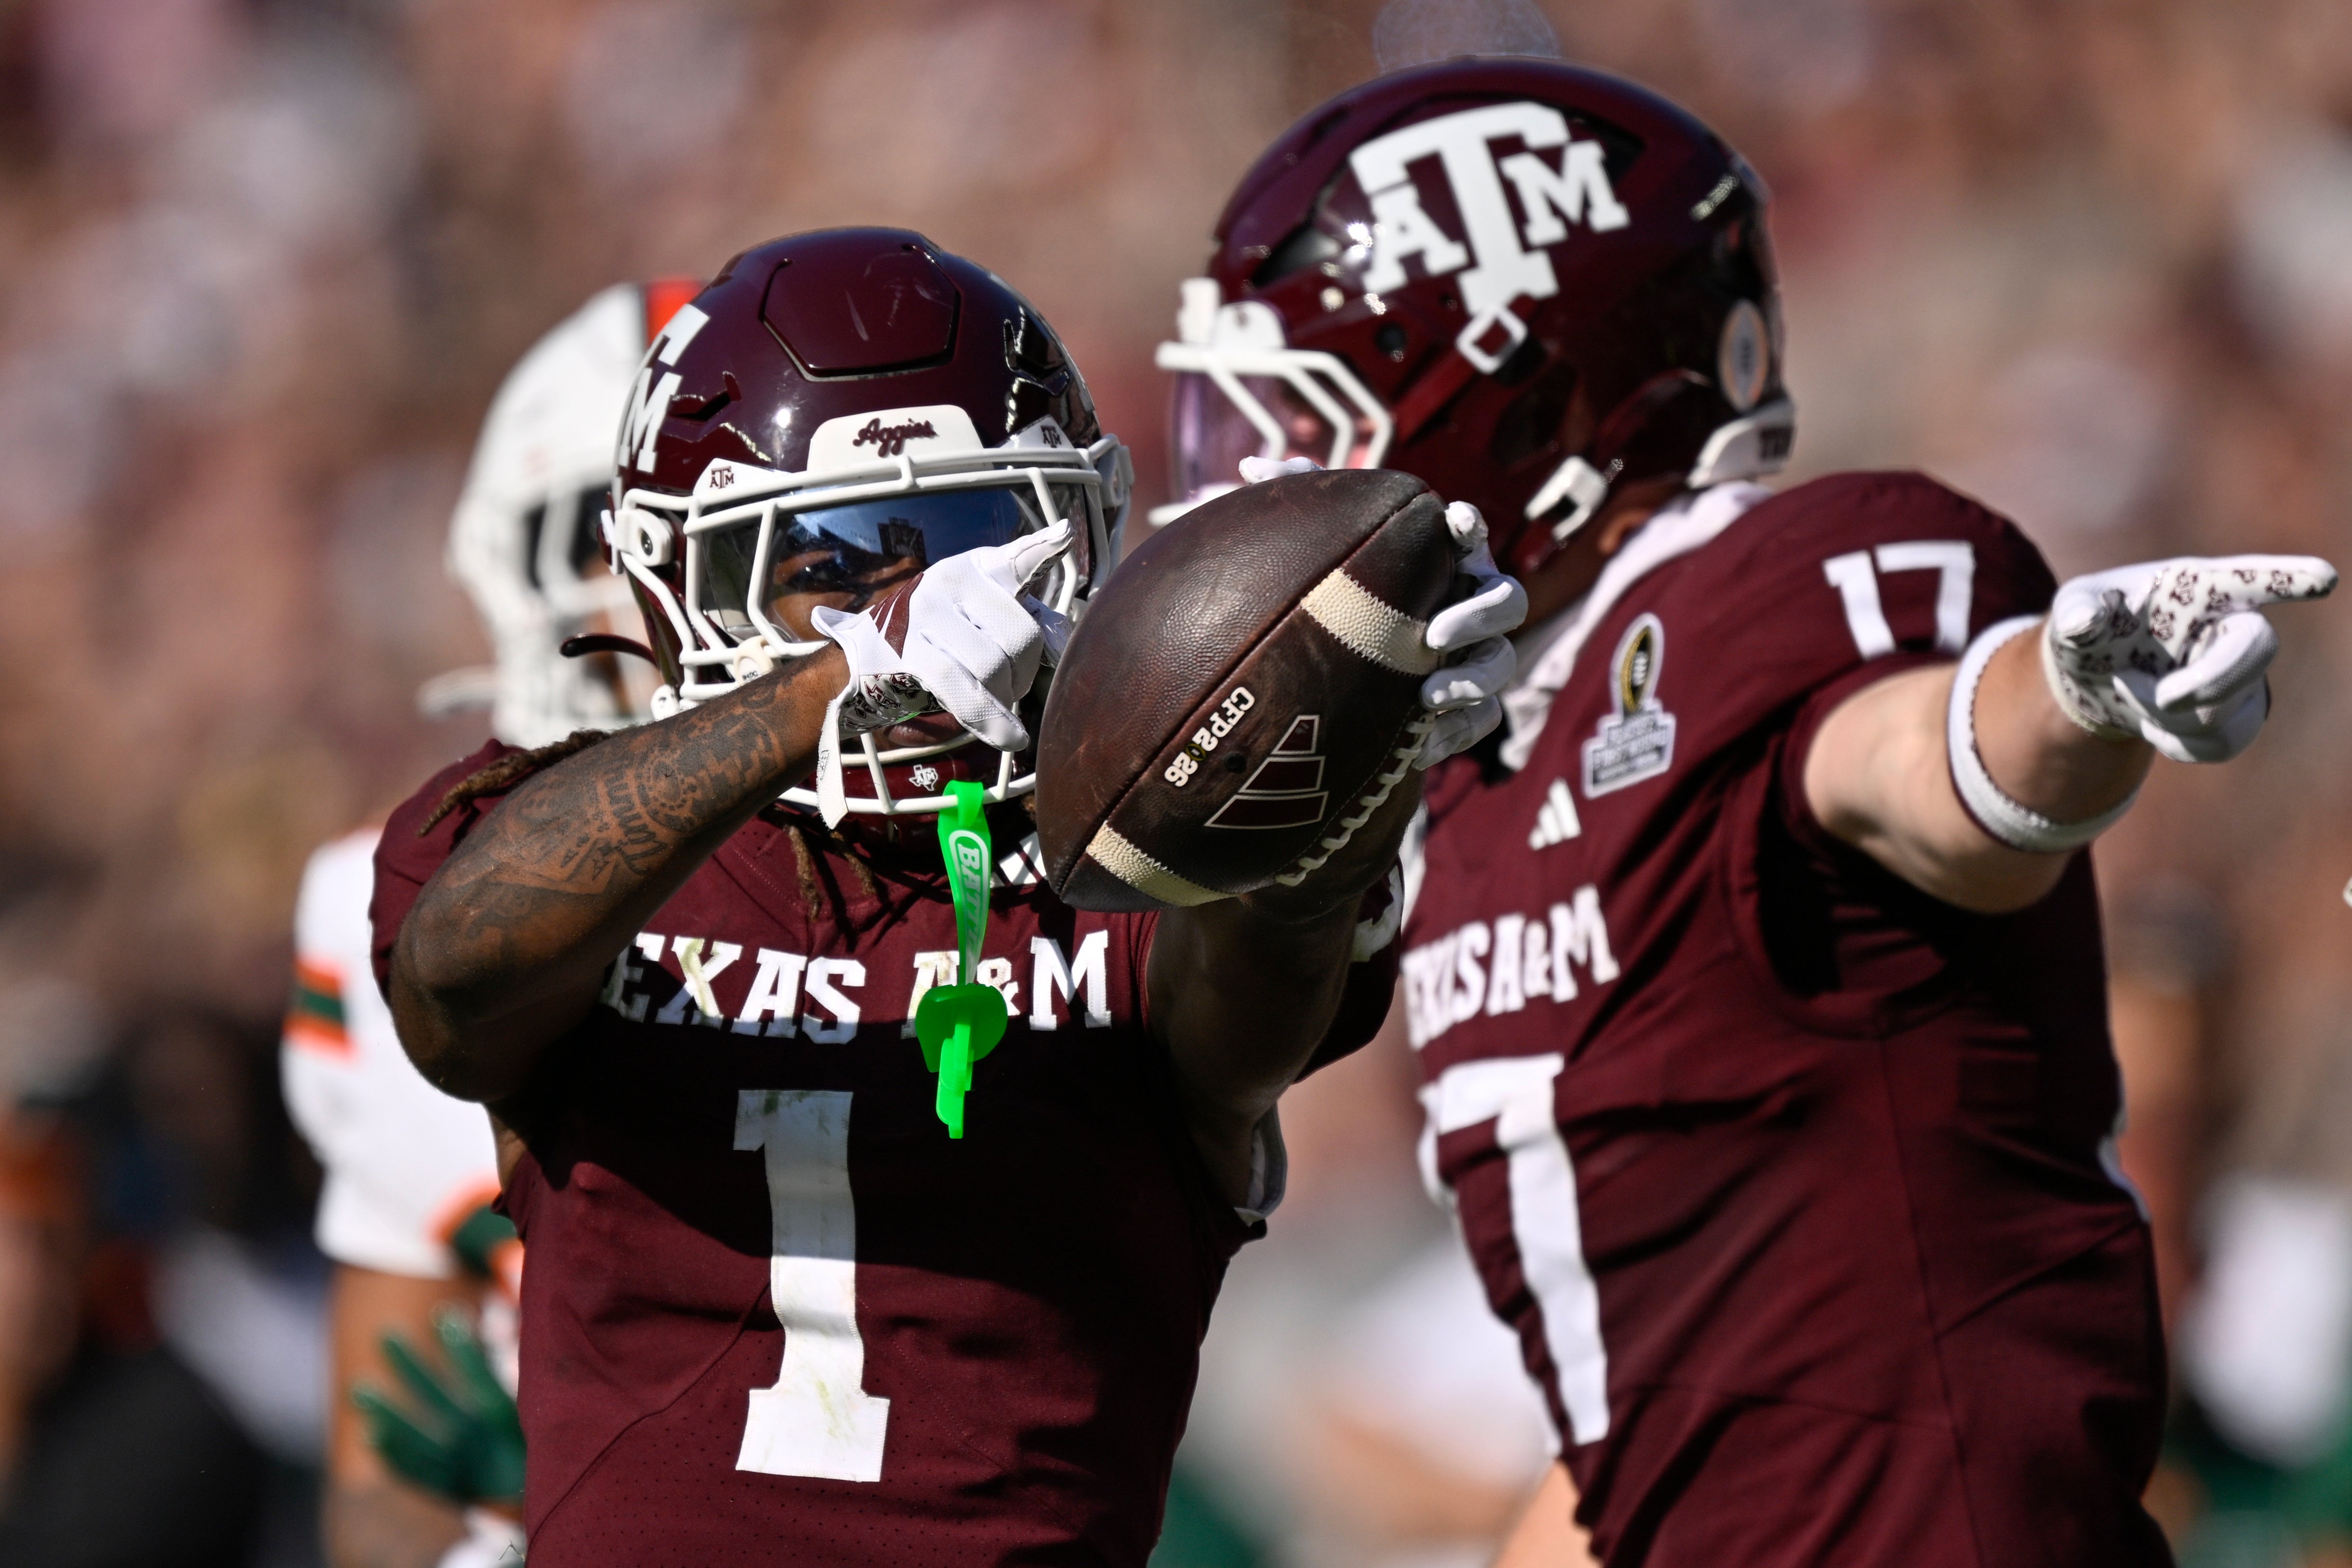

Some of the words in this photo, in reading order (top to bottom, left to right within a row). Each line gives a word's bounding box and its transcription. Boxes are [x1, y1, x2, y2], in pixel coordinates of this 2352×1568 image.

[853, 418, 938, 457] Aggies
[1823, 540, 1975, 660] 17
[599, 932, 866, 1044] EXAS
[733, 1090, 890, 1482] 1
